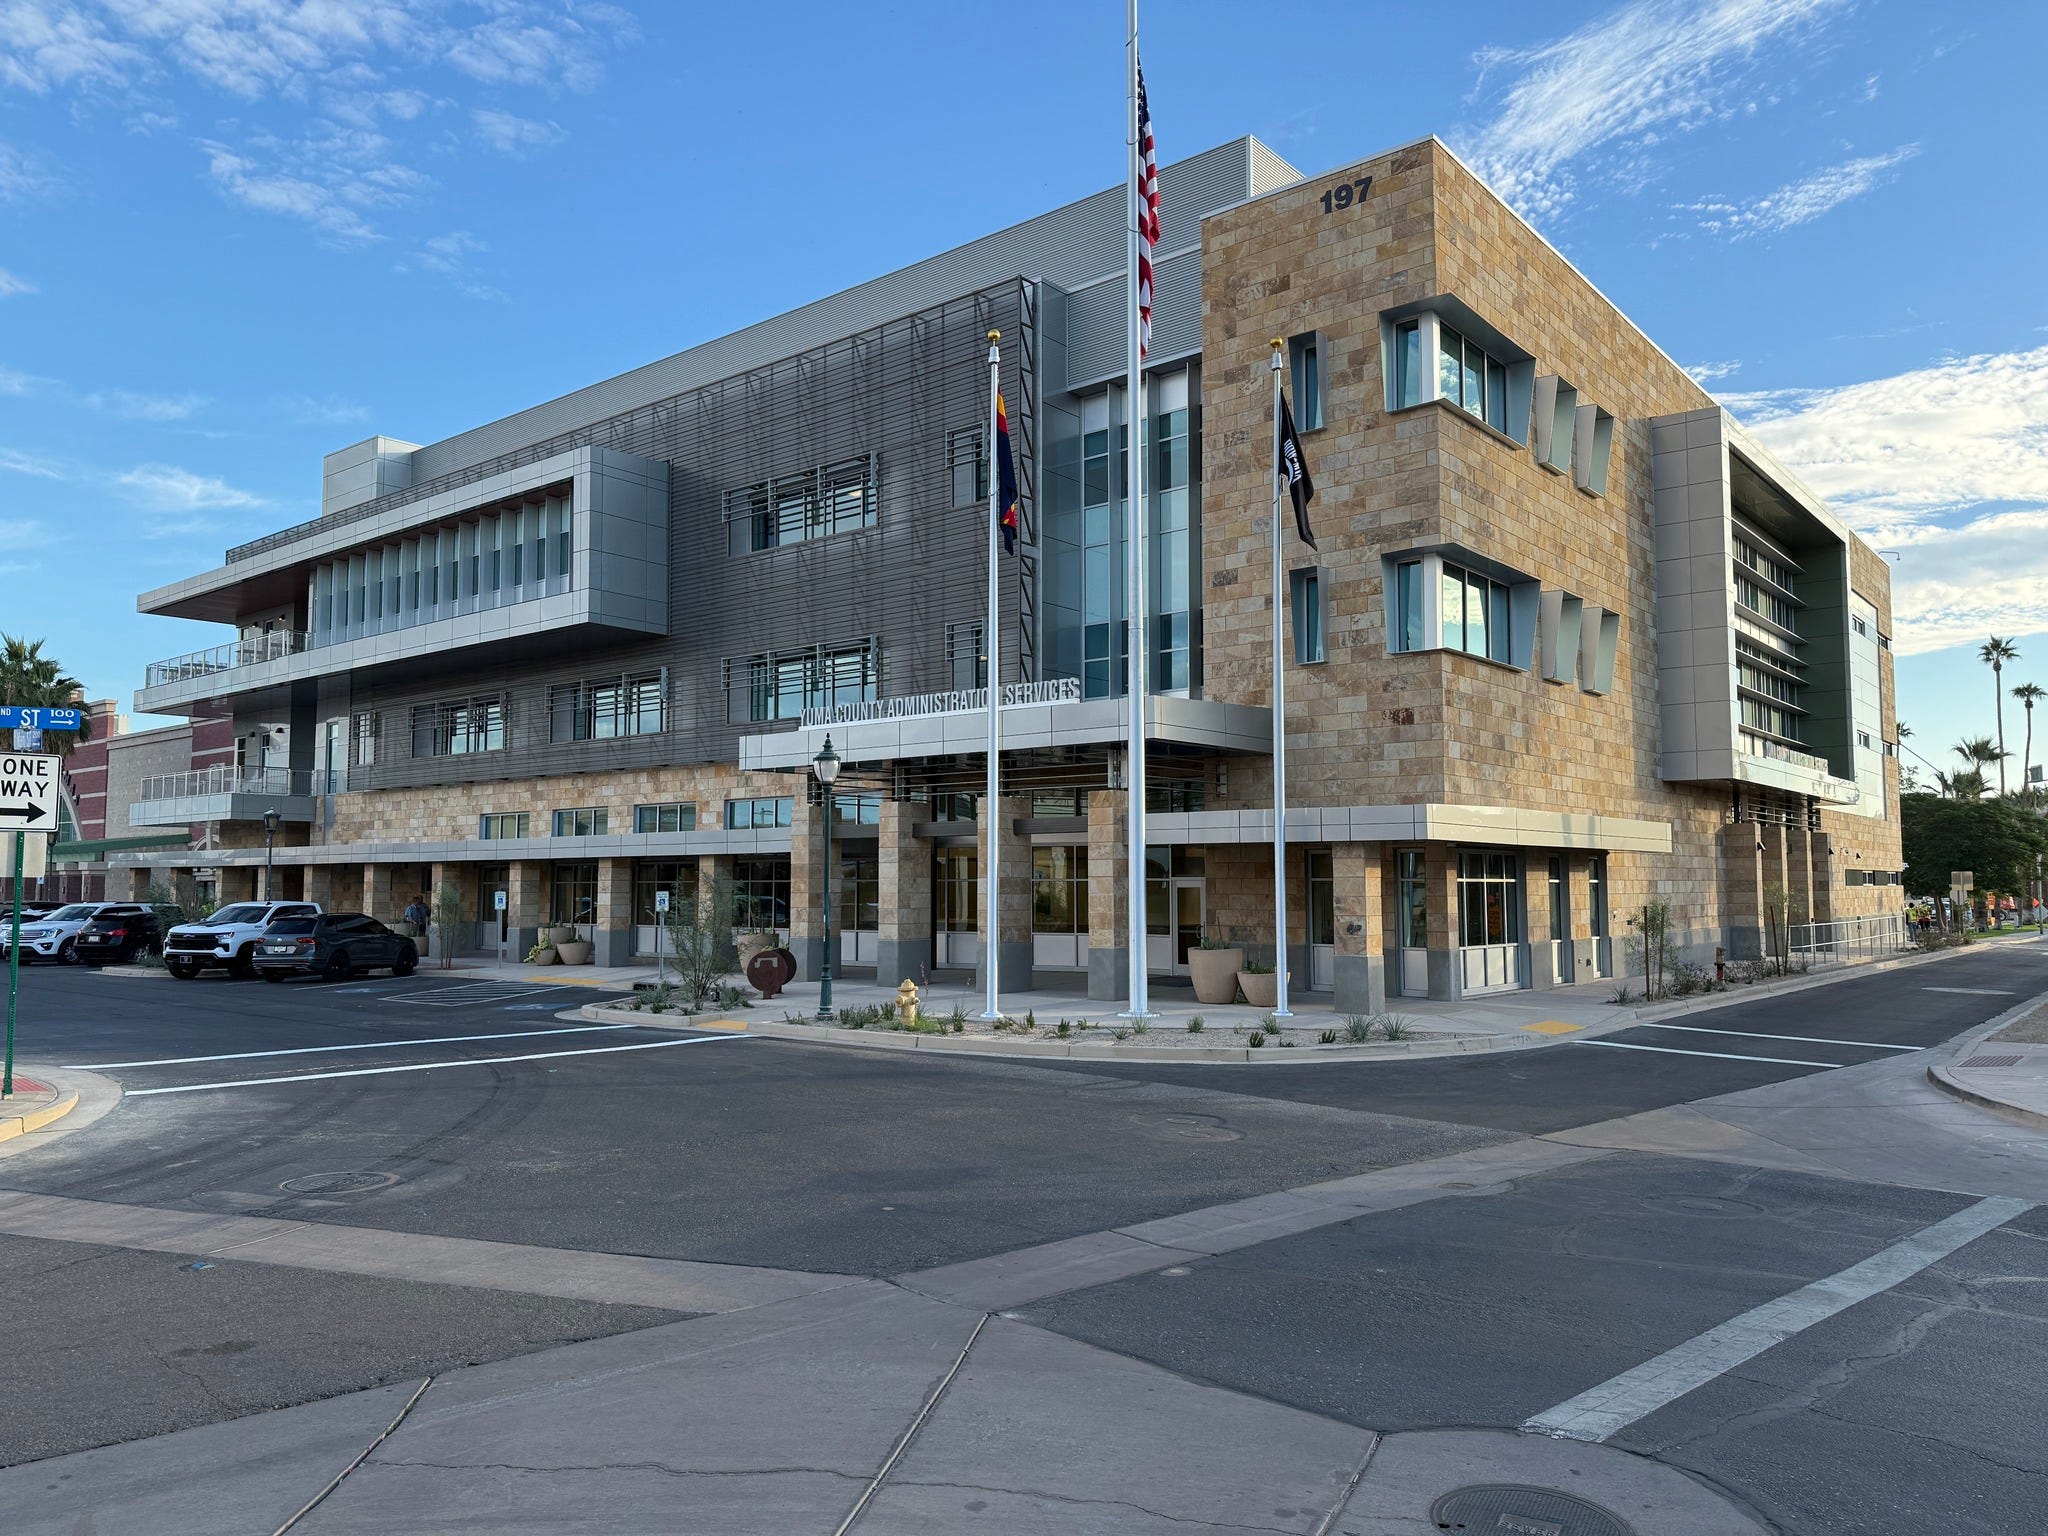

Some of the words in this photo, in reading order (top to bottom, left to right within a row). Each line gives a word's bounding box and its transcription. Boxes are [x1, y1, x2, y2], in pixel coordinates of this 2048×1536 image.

[1320, 176, 1373, 215] 197
[800, 704, 833, 728] YUMA
[836, 699, 885, 723] COUNTY
[1005, 677, 1081, 706] SERVICES
[0, 708, 11, 716] ND
[20, 709, 41, 727] ST
[50, 709, 75, 718] 100
[3, 758, 48, 776] ONE
[1, 780, 49, 797] WAY
